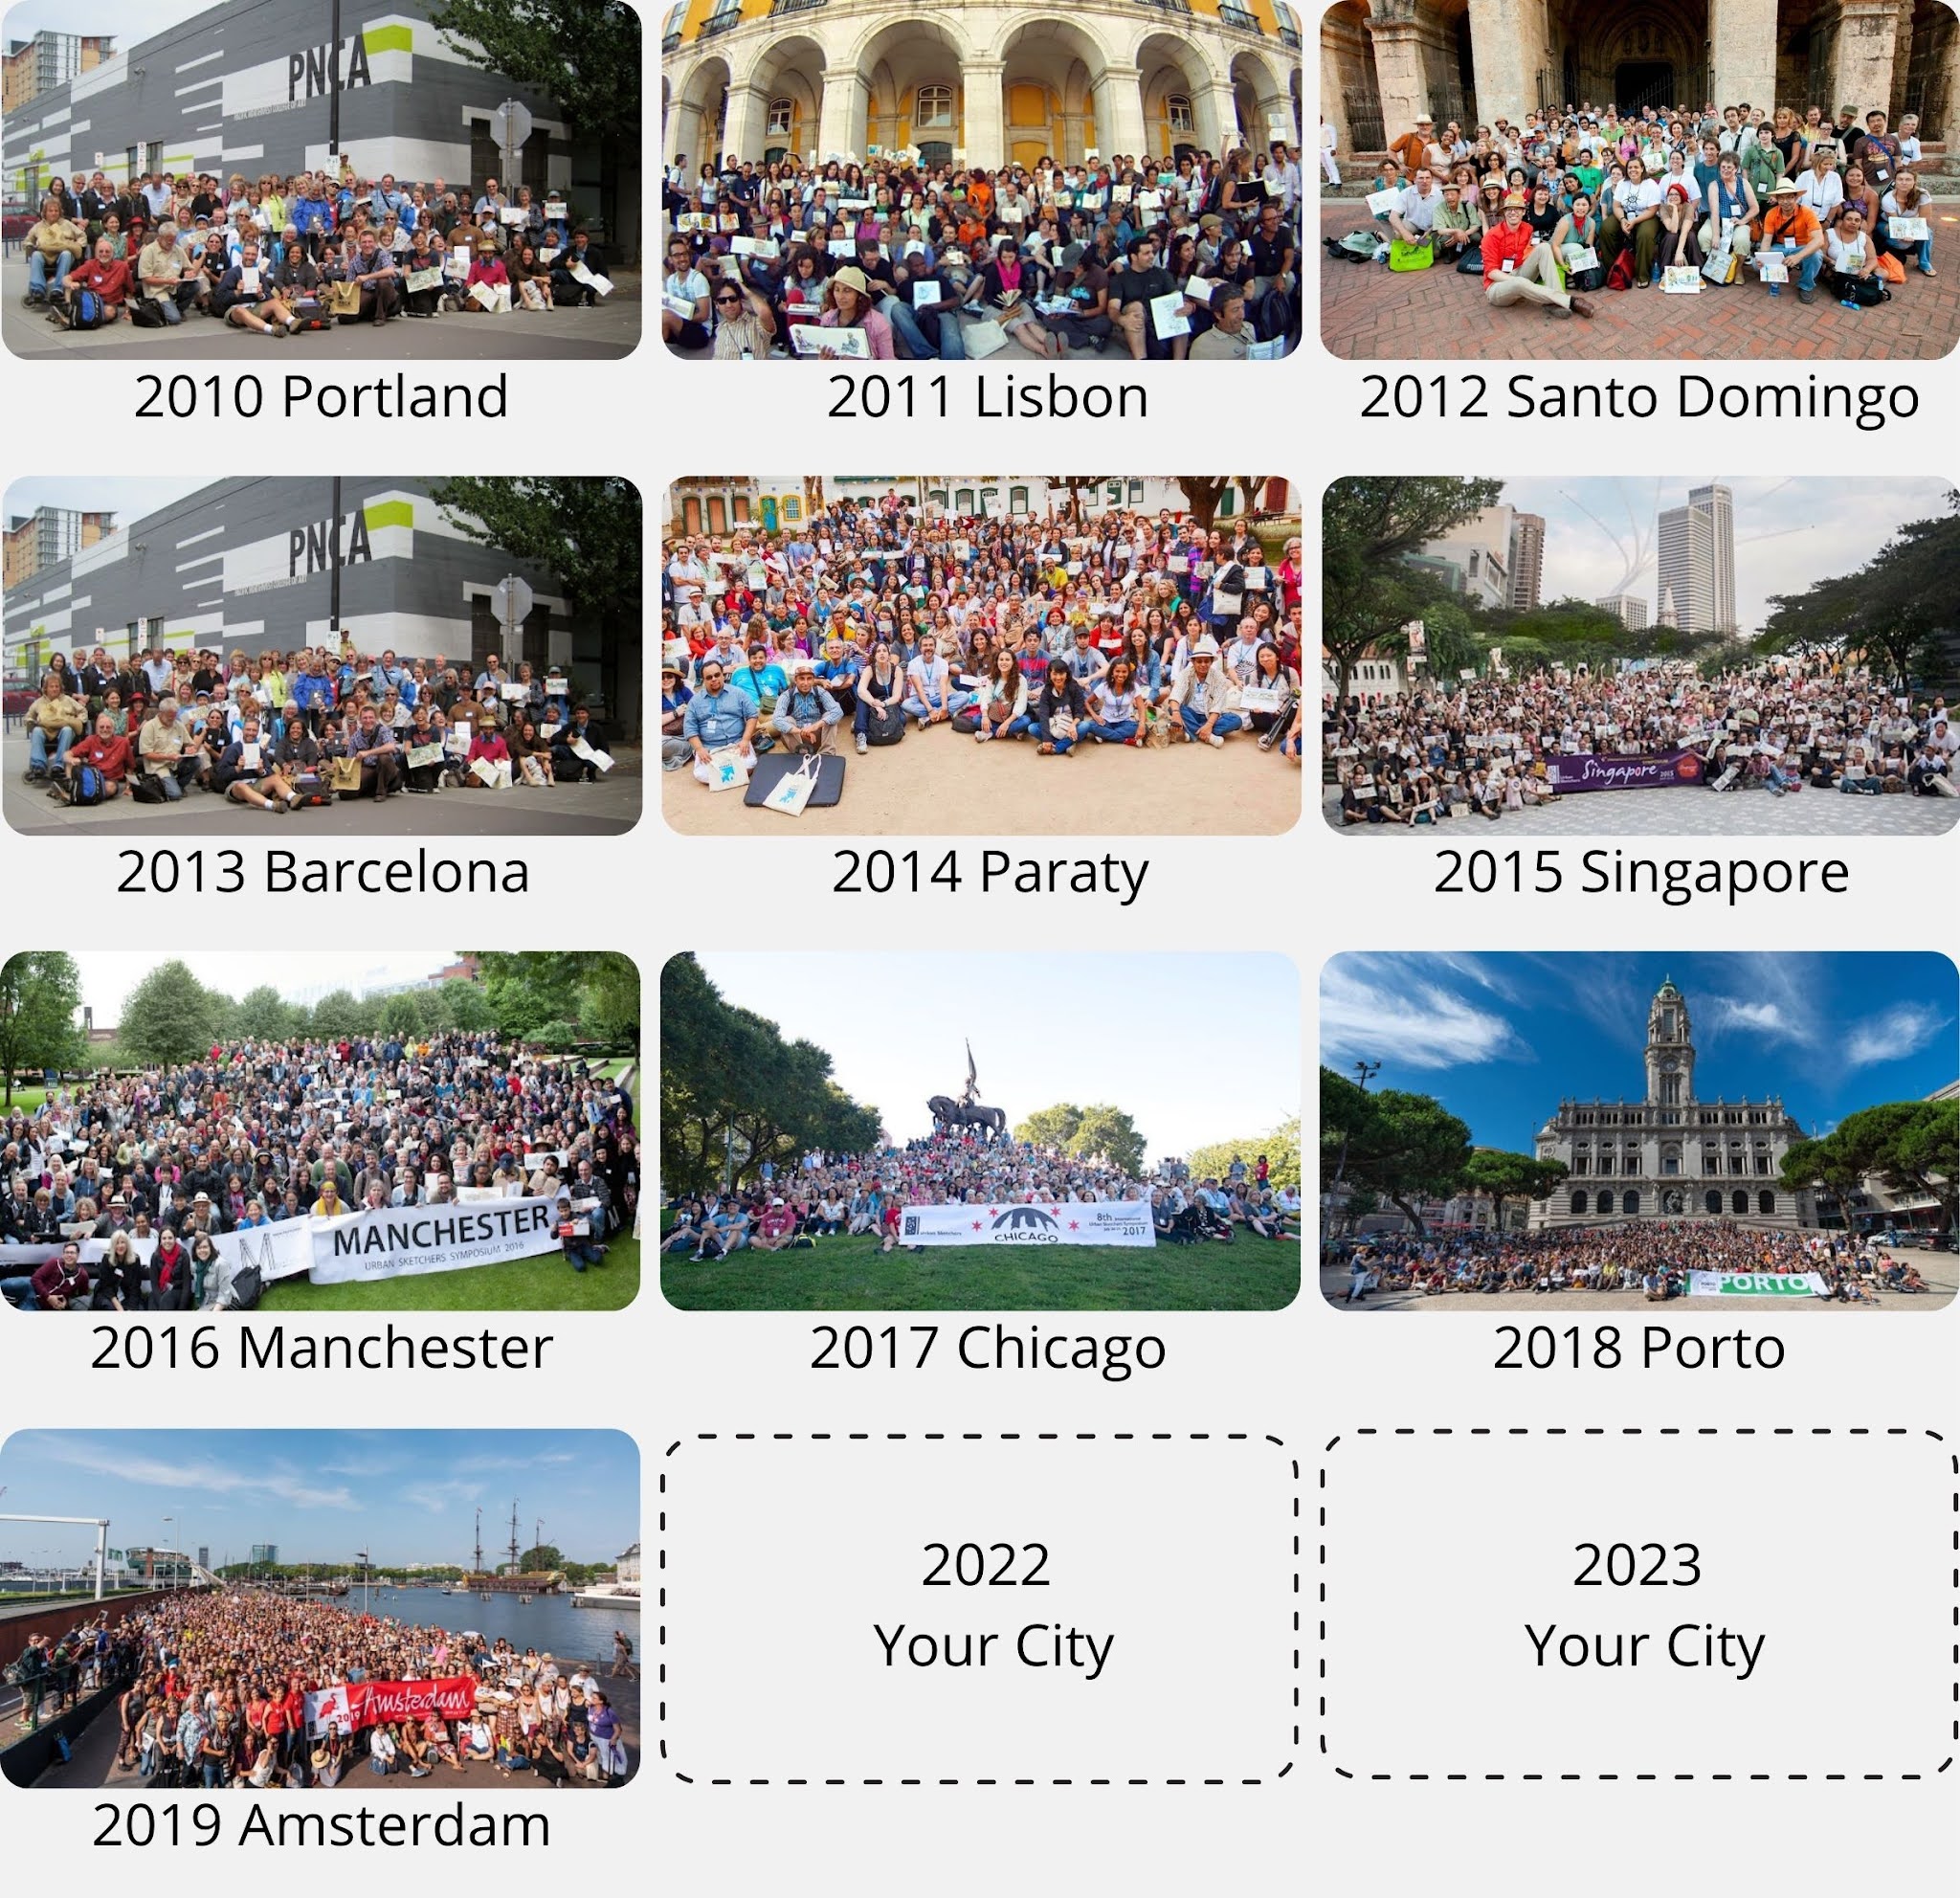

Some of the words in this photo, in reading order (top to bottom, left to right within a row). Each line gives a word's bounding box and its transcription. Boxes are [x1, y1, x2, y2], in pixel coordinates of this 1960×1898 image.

[289, 33, 371, 100] PNCA
[289, 509, 372, 576] PNCA
[1582, 759, 1659, 785] Singapore
[334, 1204, 549, 1256] MANCHESTER
[1097, 1213, 1112, 1221] 8th
[994, 1231, 1058, 1243] CHICAGO
[1123, 1226, 1146, 1236] 2017
[365, 1259, 394, 1271] URBAN
[398, 1252, 447, 1266] SKETCHERS
[450, 1244, 501, 1260] SYMPOSIUM
[505, 1241, 524, 1252] 2016
[1720, 1274, 1809, 1290] PORTO
[350, 1683, 470, 1716] Amsterdam
[337, 1711, 361, 1723] 2019
